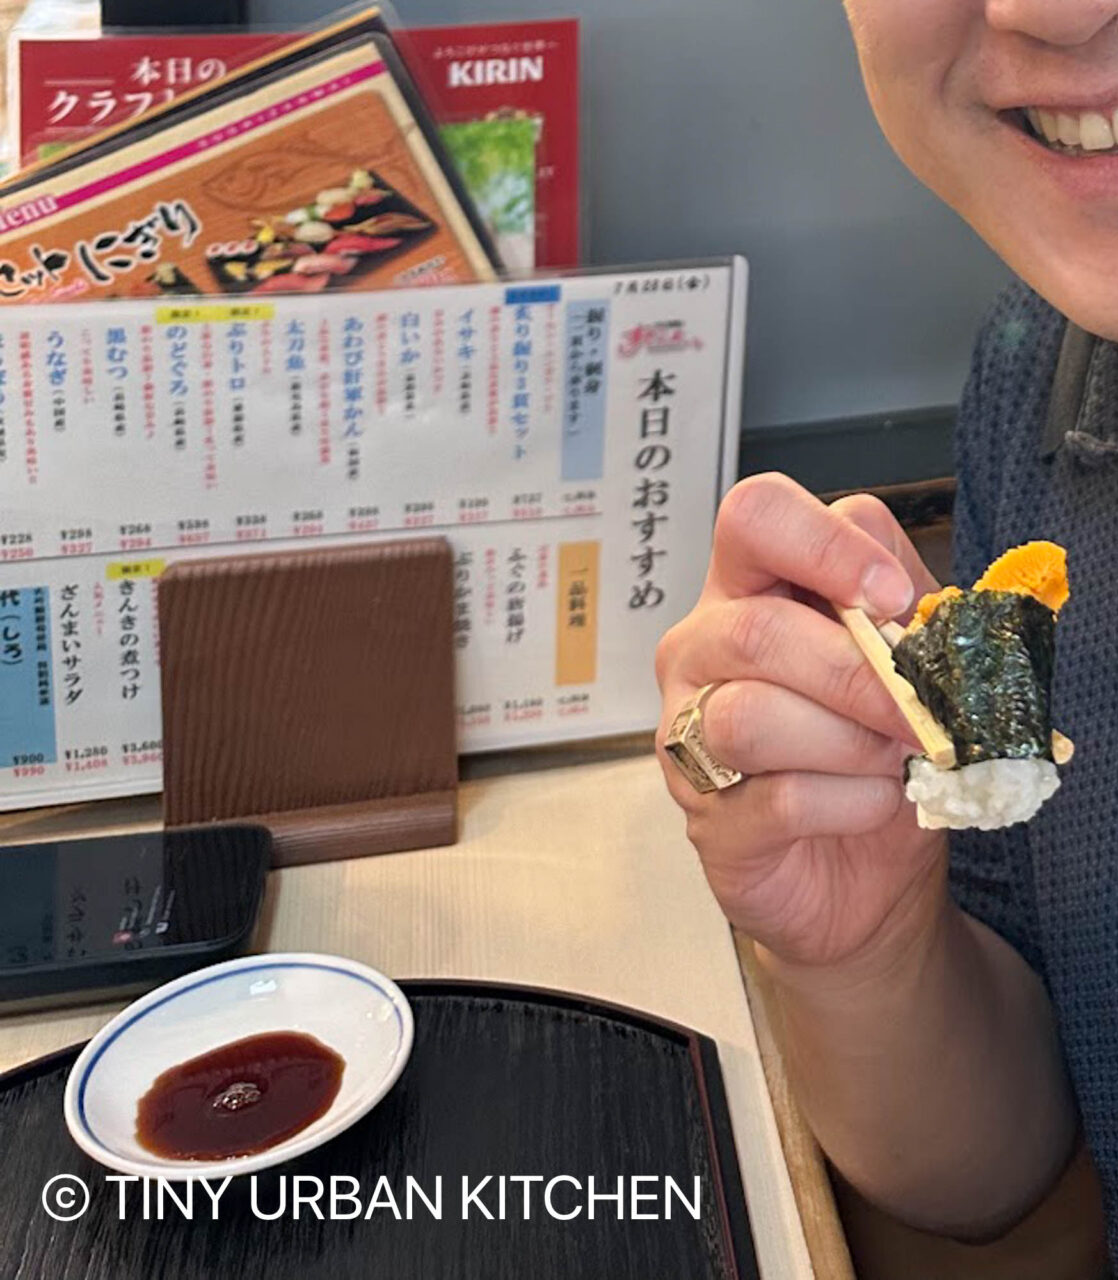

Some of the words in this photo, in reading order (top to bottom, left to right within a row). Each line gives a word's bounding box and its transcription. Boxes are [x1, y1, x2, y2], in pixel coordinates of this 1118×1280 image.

[131, 56, 227, 85] 本日の
[448, 56, 544, 87] KIRIN
[46, 330, 67, 387] うなぎ
[106, 327, 129, 380] 黒むつ
[167, 325, 189, 397] のどぐろ
[227, 323, 247, 392] ぶりトロ
[628, 369, 678, 610] 本日のおすすめ
[567, 566, 589, 628] 一品料理
[59, 583, 84, 706] ざんまいサラダ
[118, 578, 141, 700] きんきの煮つけ
[12, 752, 45, 766] ¥900
[13, 765, 46, 779] ¥990
